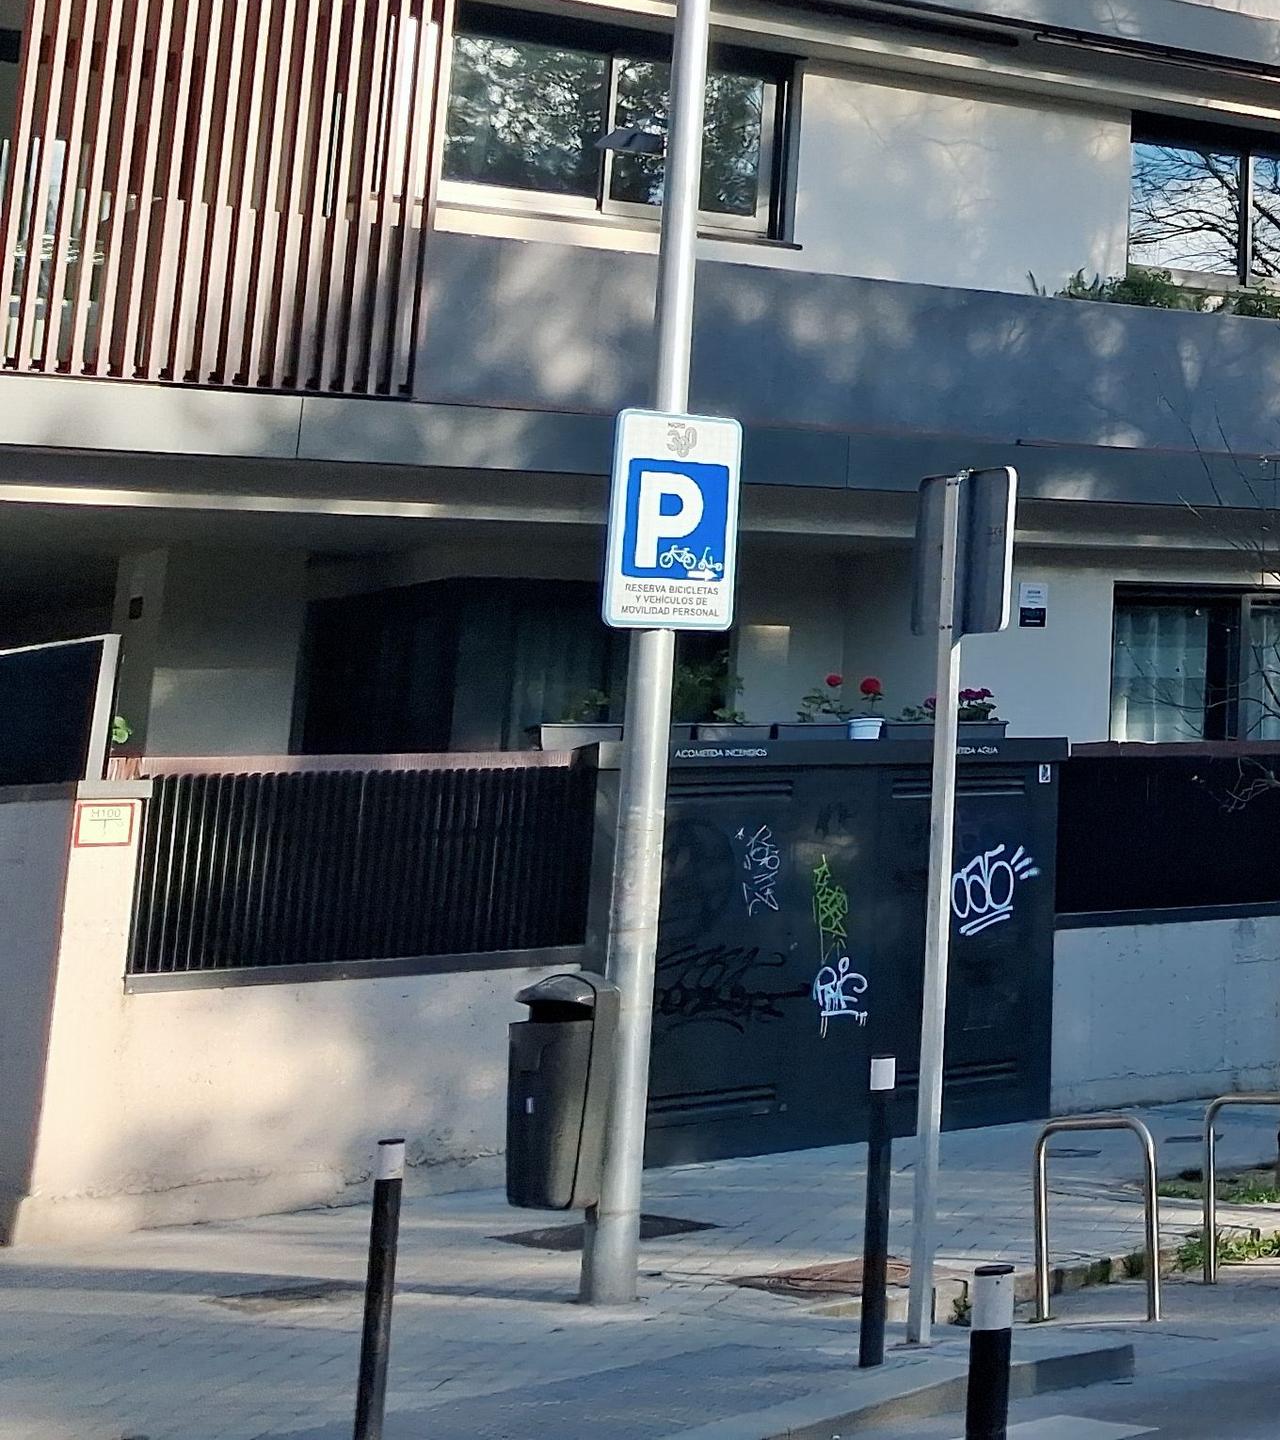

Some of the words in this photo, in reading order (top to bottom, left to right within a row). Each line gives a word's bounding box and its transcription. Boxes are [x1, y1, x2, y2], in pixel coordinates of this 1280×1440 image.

[634, 471, 704, 568] P
[625, 583, 666, 593] RESERVA
[668, 585, 719, 595] BICICLETAS
[635, 595, 641, 603] Y
[695, 597, 708, 606] DE
[621, 605, 670, 615] MOVILIDAD
[672, 607, 719, 617] PERSONAL
